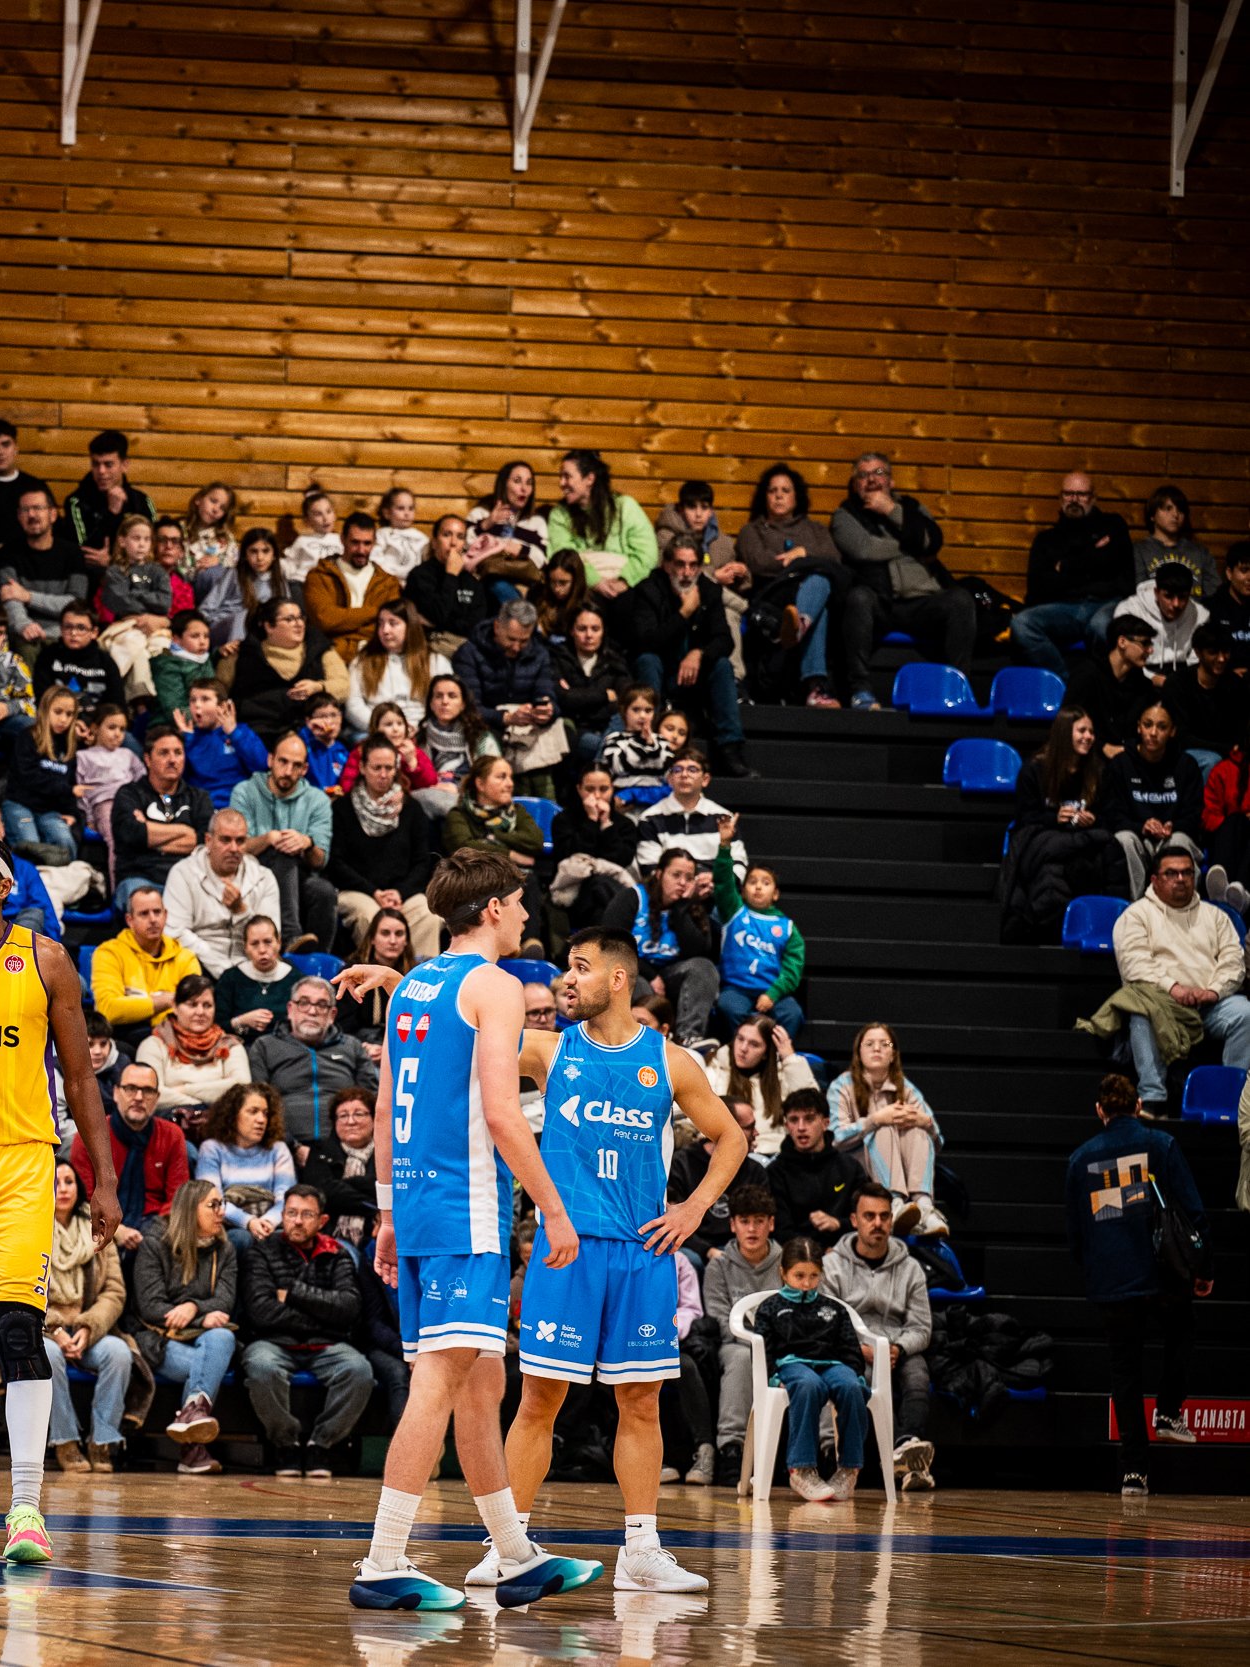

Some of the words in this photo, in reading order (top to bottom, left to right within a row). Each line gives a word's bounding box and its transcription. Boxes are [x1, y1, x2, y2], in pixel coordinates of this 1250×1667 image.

[394, 1058, 420, 1144] 5
[584, 1100, 654, 1128] Class
[614, 1128, 631, 1140] Rent
[640, 1134, 654, 1142] car
[392, 1158, 412, 1166] HOTEL
[596, 1148, 618, 1180] 10
[562, 1324, 576, 1332] Ibiza
[558, 1338, 580, 1348] Hotels
[560, 1331, 582, 1342] Feeling
[1194, 1408, 1246, 1430] CANASTA
